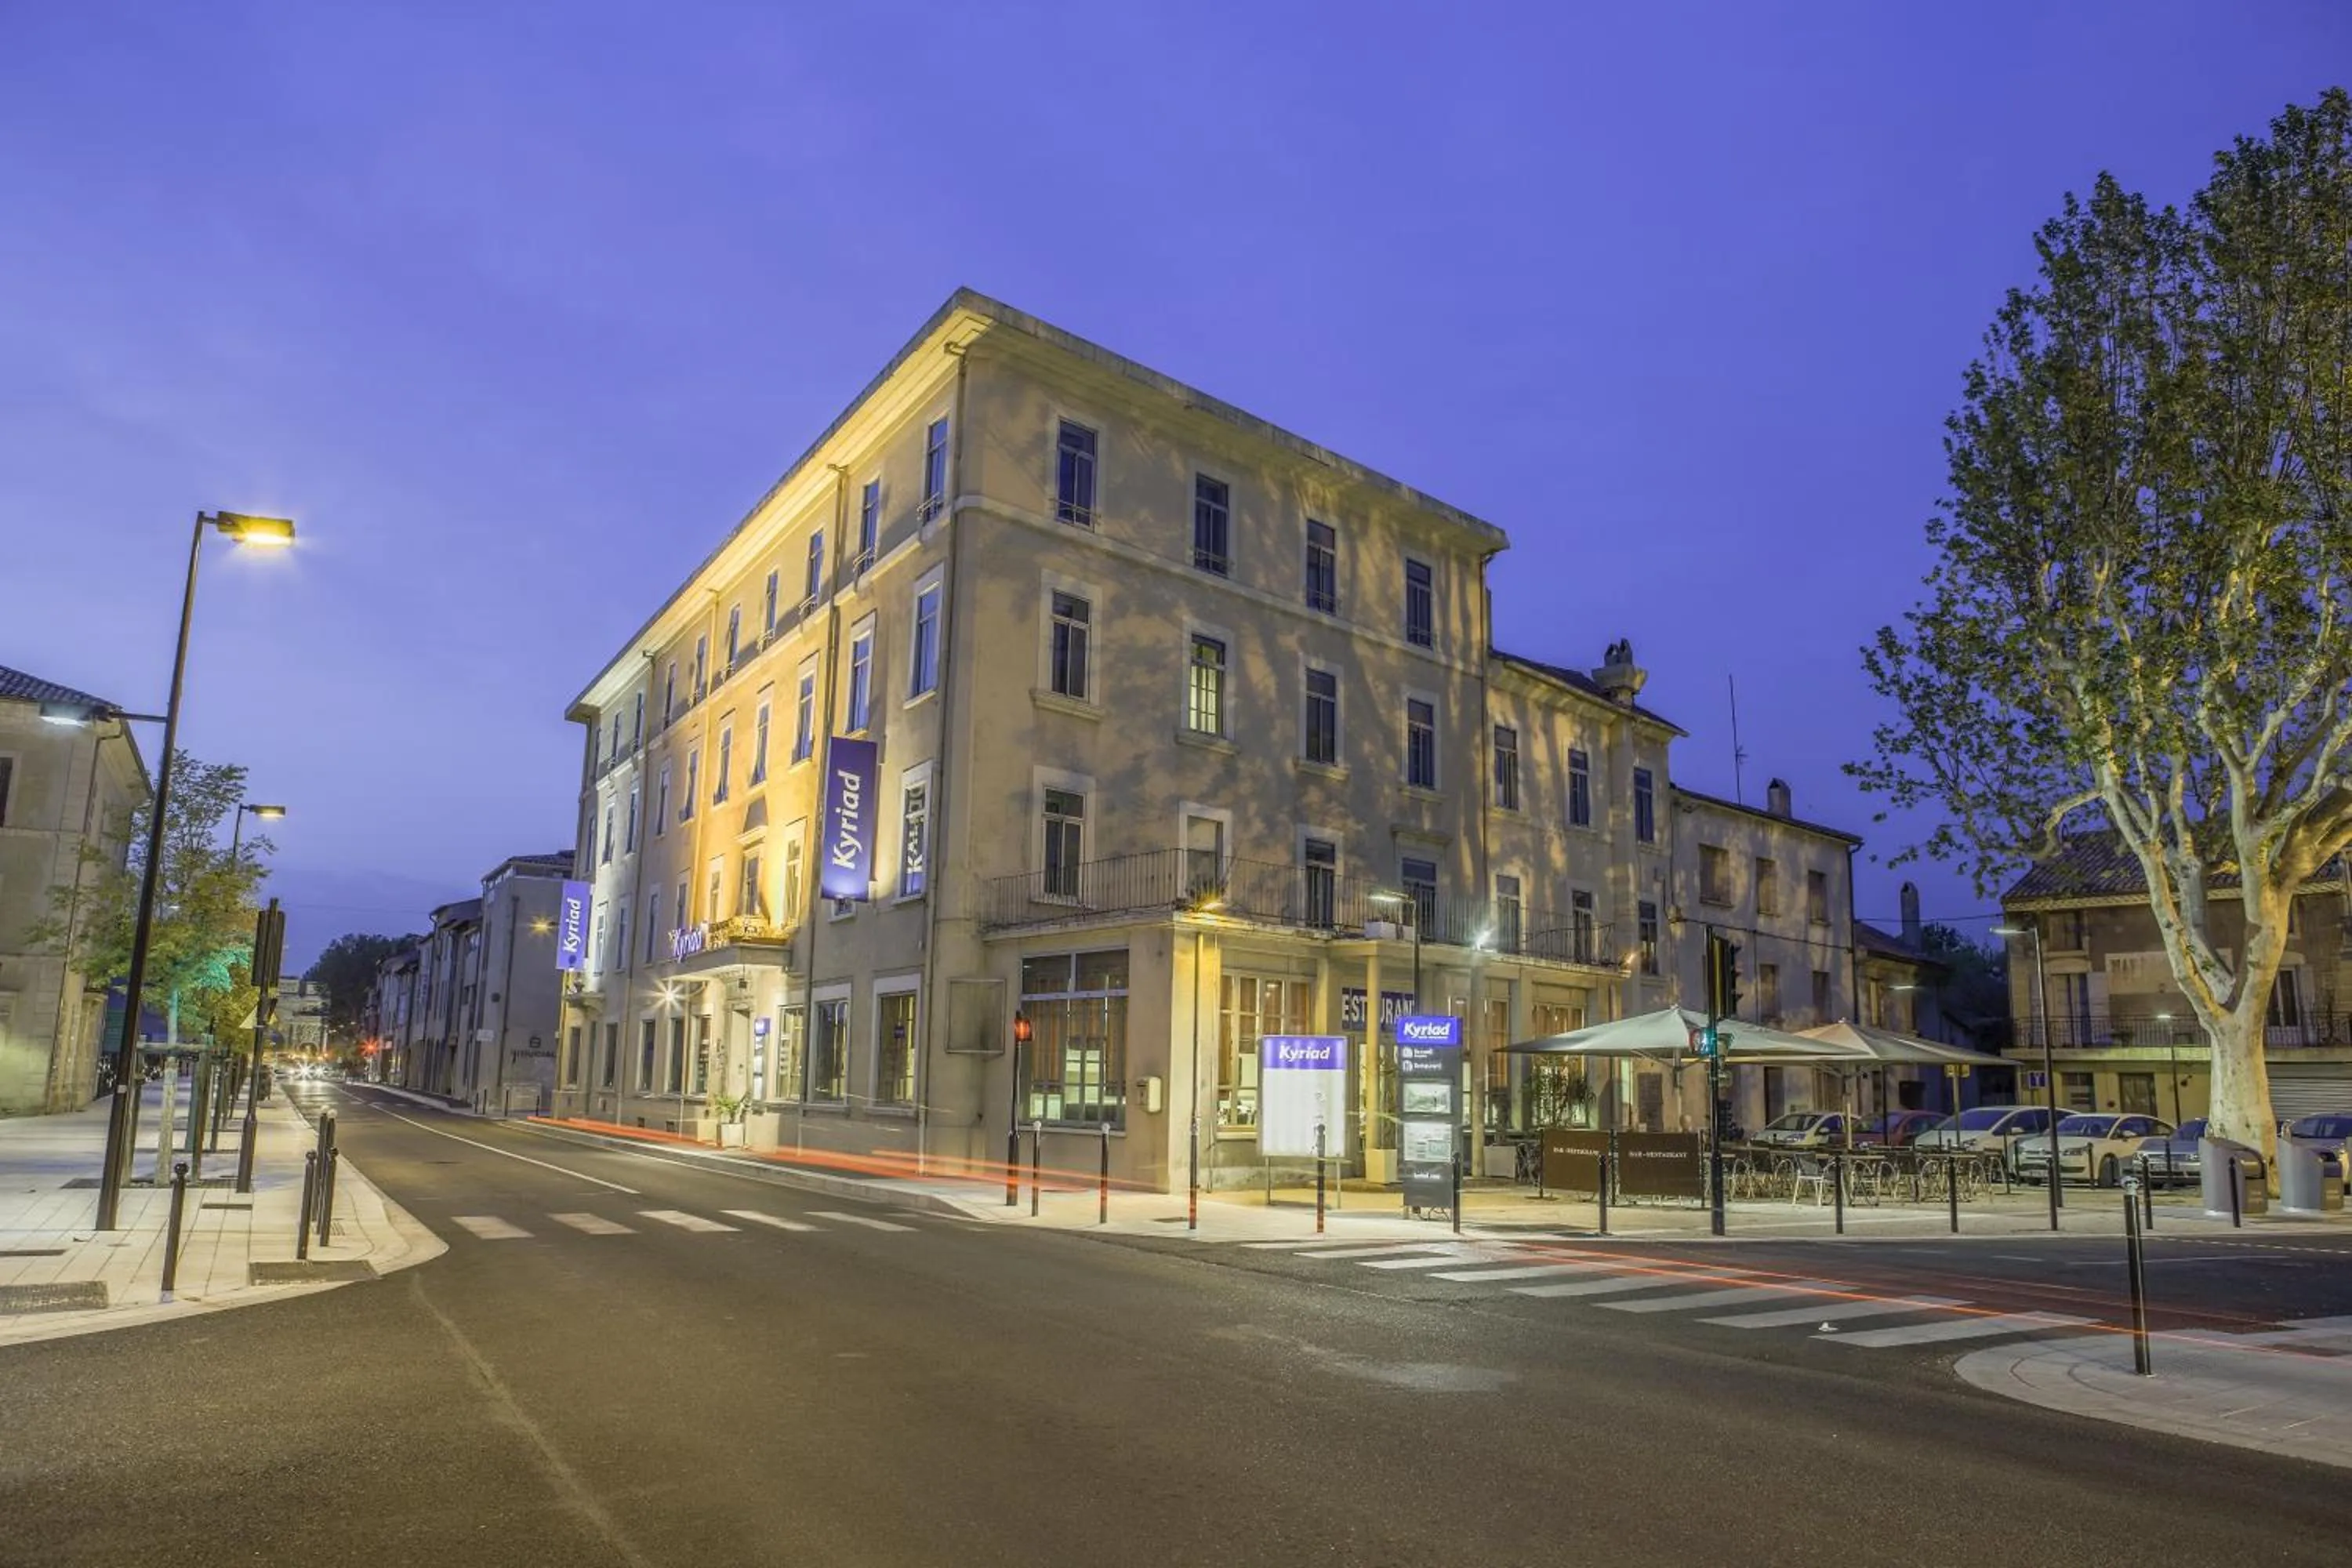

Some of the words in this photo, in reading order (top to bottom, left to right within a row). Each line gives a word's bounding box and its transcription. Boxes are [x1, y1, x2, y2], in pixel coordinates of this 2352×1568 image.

[831, 768, 863, 870] Kyriad
[562, 897, 582, 953] Kyriad
[1403, 1022, 1450, 1039] Kyriad
[1279, 1044, 1330, 1062] Kyriad
